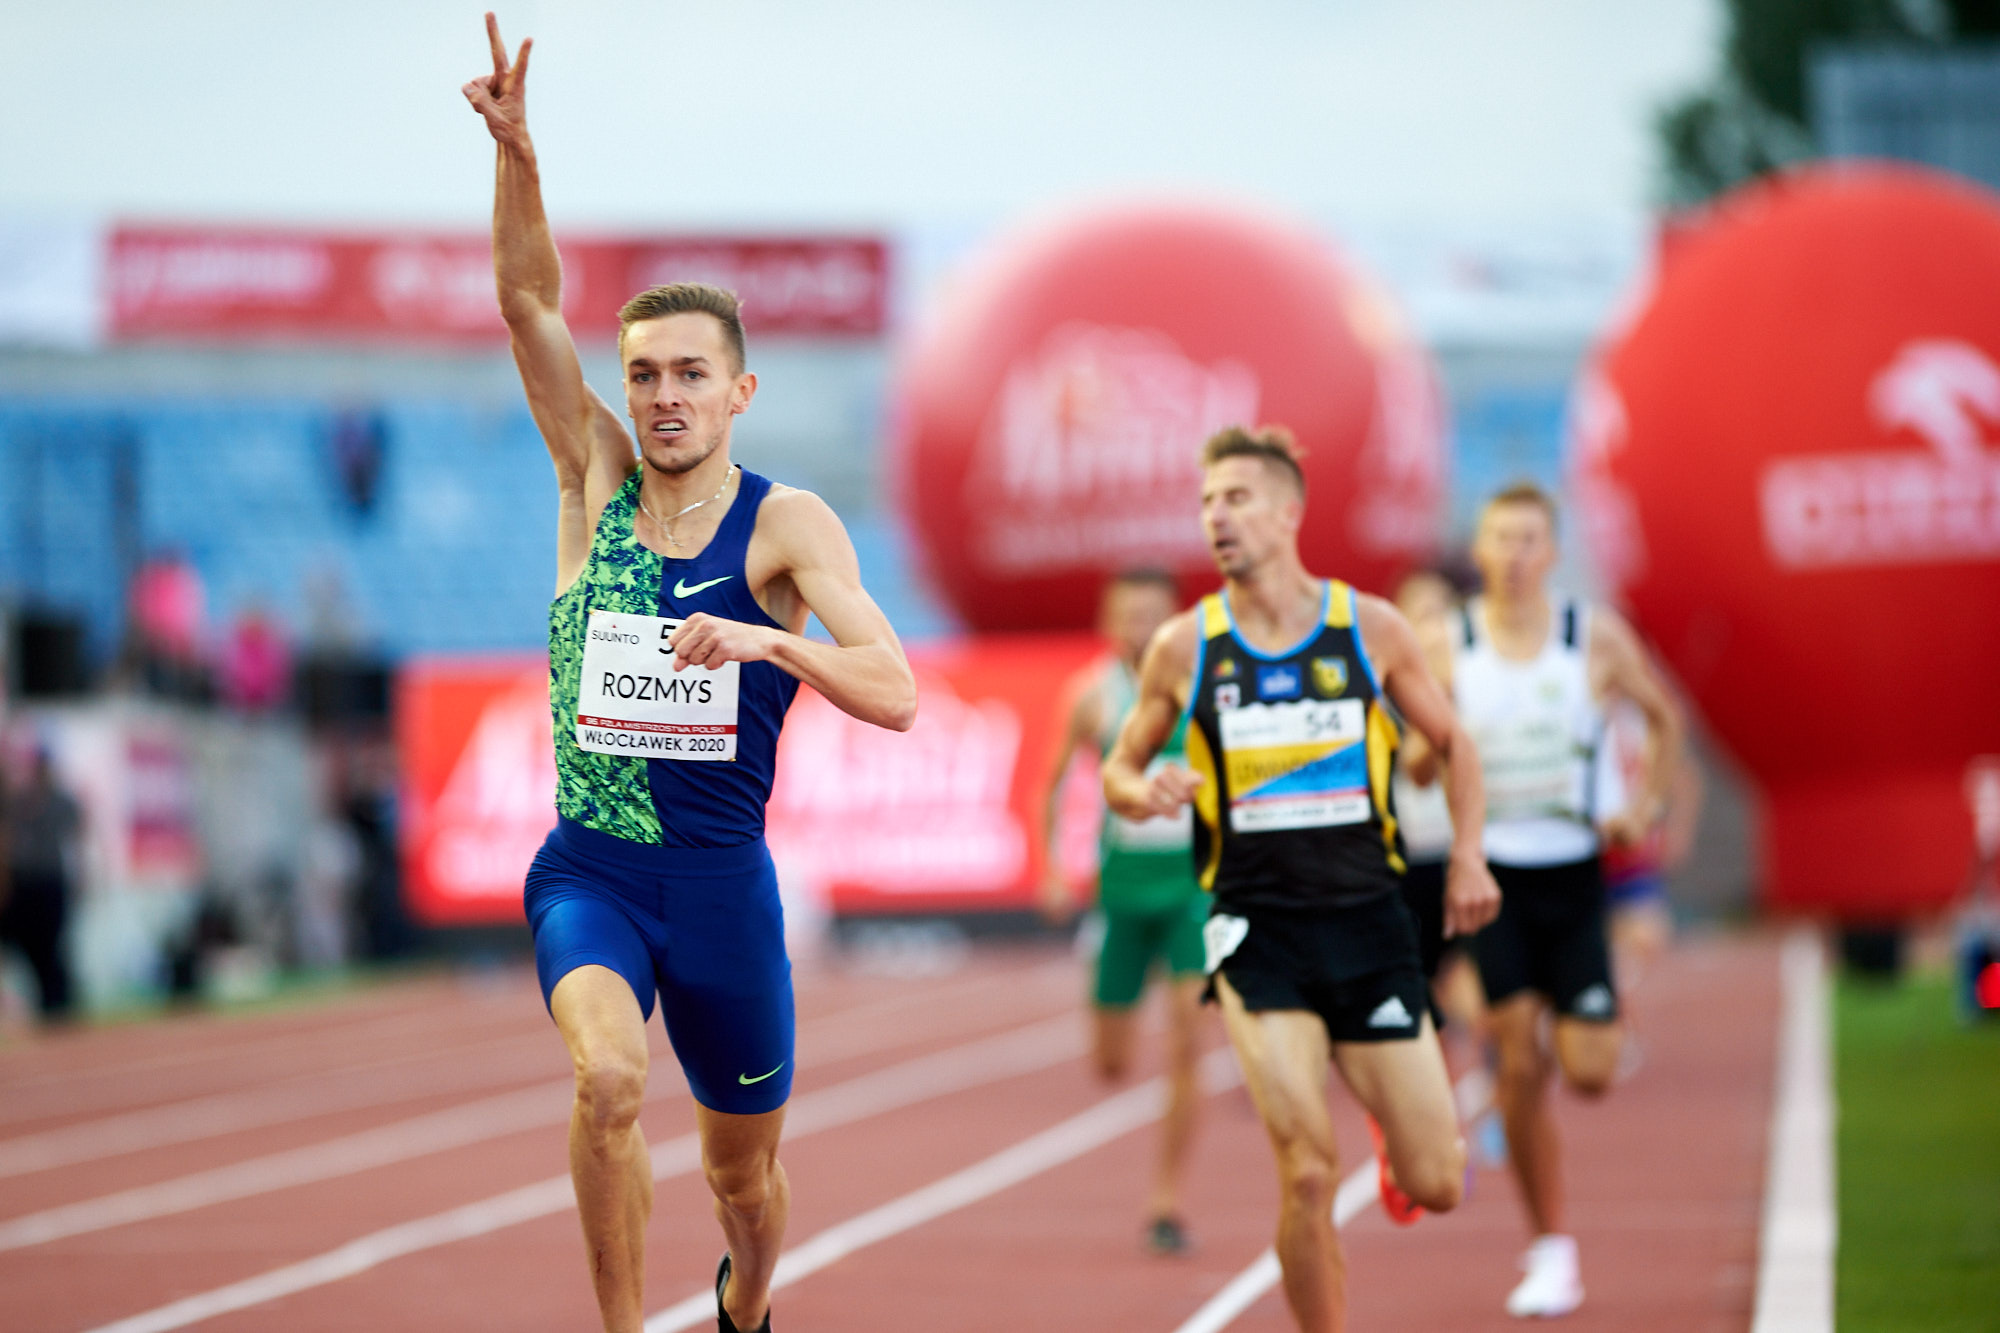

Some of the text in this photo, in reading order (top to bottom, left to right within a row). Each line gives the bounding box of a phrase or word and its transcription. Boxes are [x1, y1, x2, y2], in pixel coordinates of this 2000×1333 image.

[591, 630, 640, 645] SUUNTO
[602, 671, 712, 704] ROZMYS
[584, 729, 726, 752] WŁOCŁAWEK 2020
